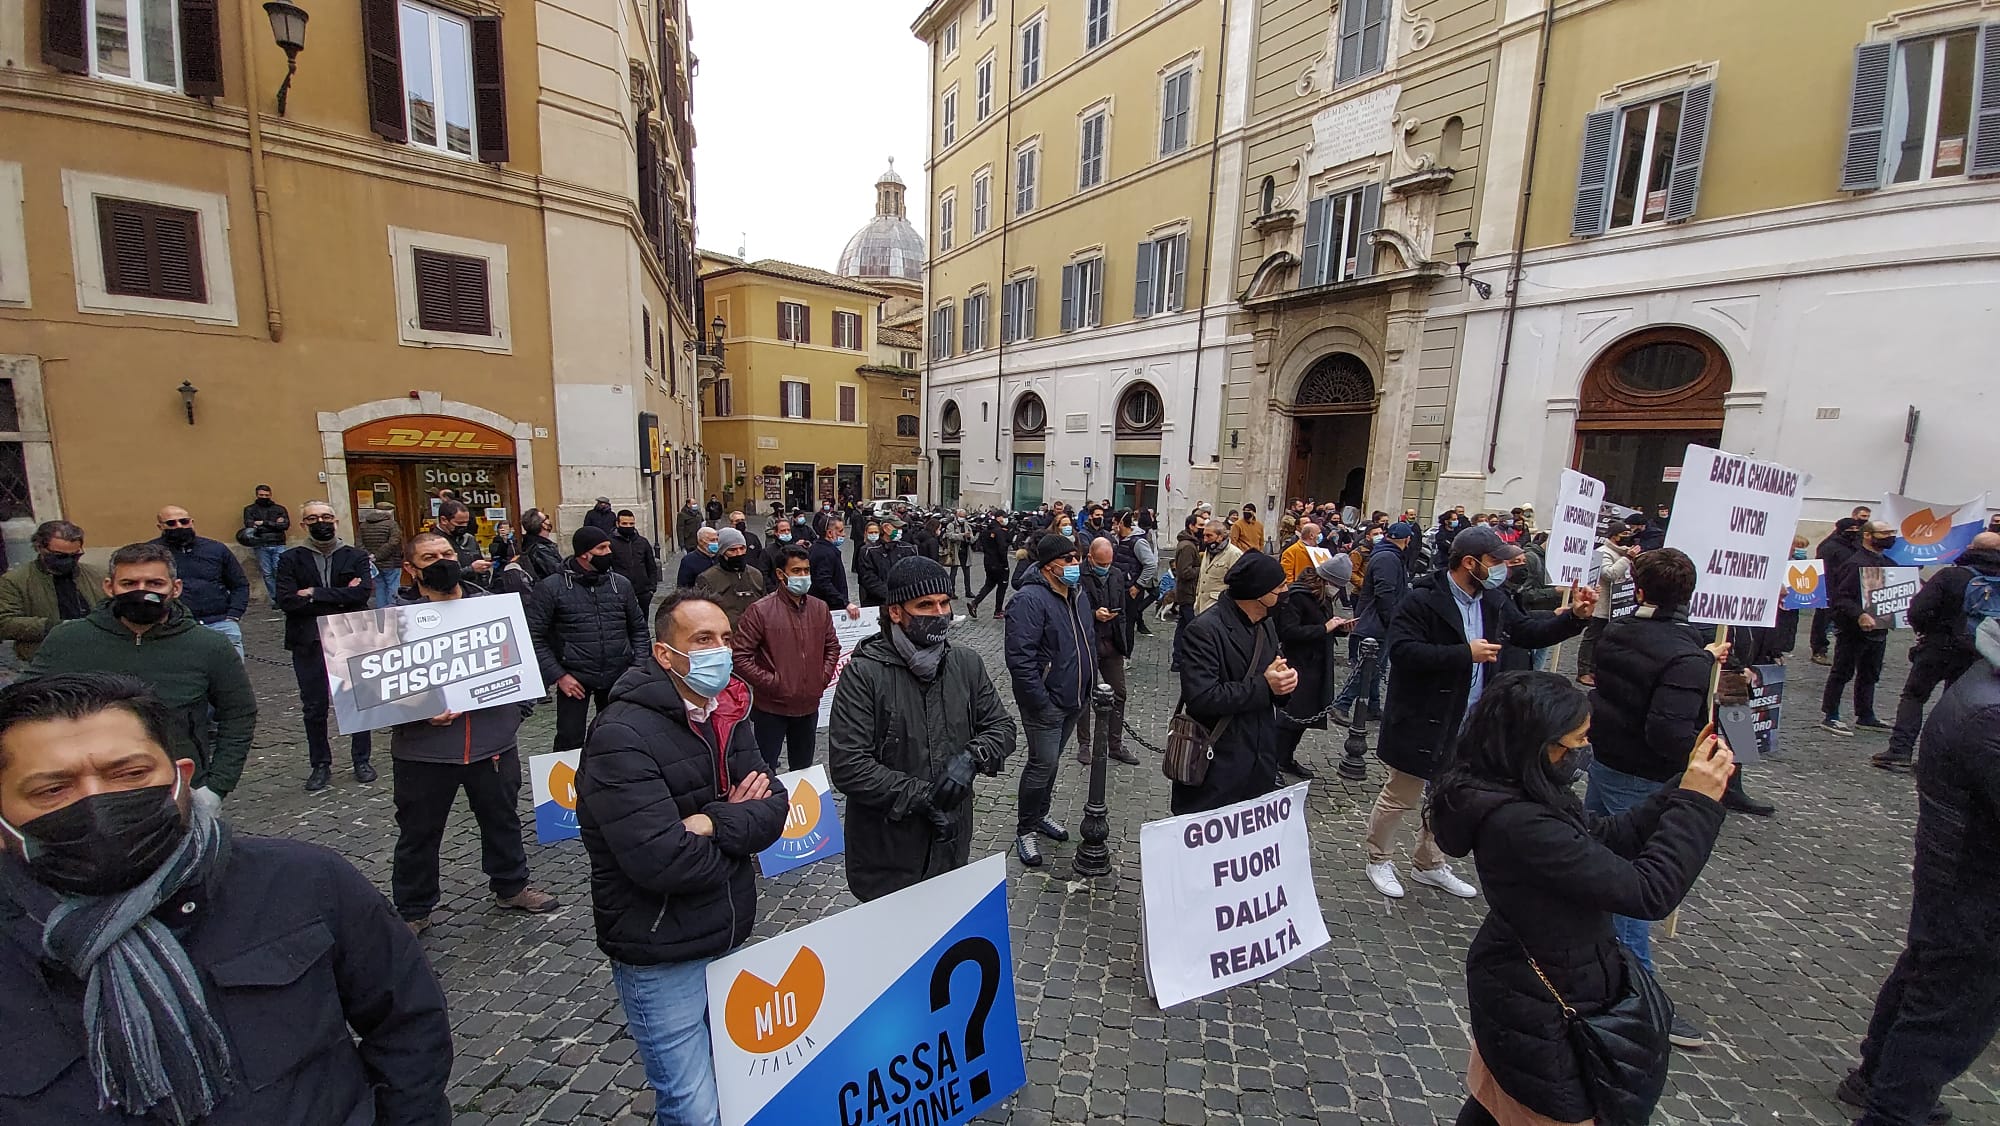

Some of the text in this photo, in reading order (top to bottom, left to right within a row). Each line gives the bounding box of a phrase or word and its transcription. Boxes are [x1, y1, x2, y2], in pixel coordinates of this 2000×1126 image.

[387, 428, 481, 449] DHL
[425, 469, 489, 486] Shop &
[1709, 455, 1747, 487] BASTA
[1747, 463, 1800, 498] CHIAMARCI
[462, 490, 501, 507] Ship
[1730, 506, 1768, 536] UNTORI
[1706, 549, 1770, 580] ALTRIMENTI
[1903, 543, 1946, 556] ITALIA
[1796, 575, 1810, 590] MIO
[1871, 582, 1915, 604] SCIOPERO
[1689, 591, 1738, 621] ARANNO
[361, 621, 508, 679] SCIOPERO
[1184, 796, 1292, 849] GOVERNO
[782, 831, 822, 852] ITALIA
[1213, 843, 1281, 887] FUORI
[1215, 885, 1288, 932] DALLA
[1210, 918, 1302, 979] REALTÀ
[754, 990, 798, 1041] MIO
[748, 1035, 816, 1077] ITALIA
[838, 1031, 957, 1126] CASSA
[876, 1077, 965, 1126] ZIONE
